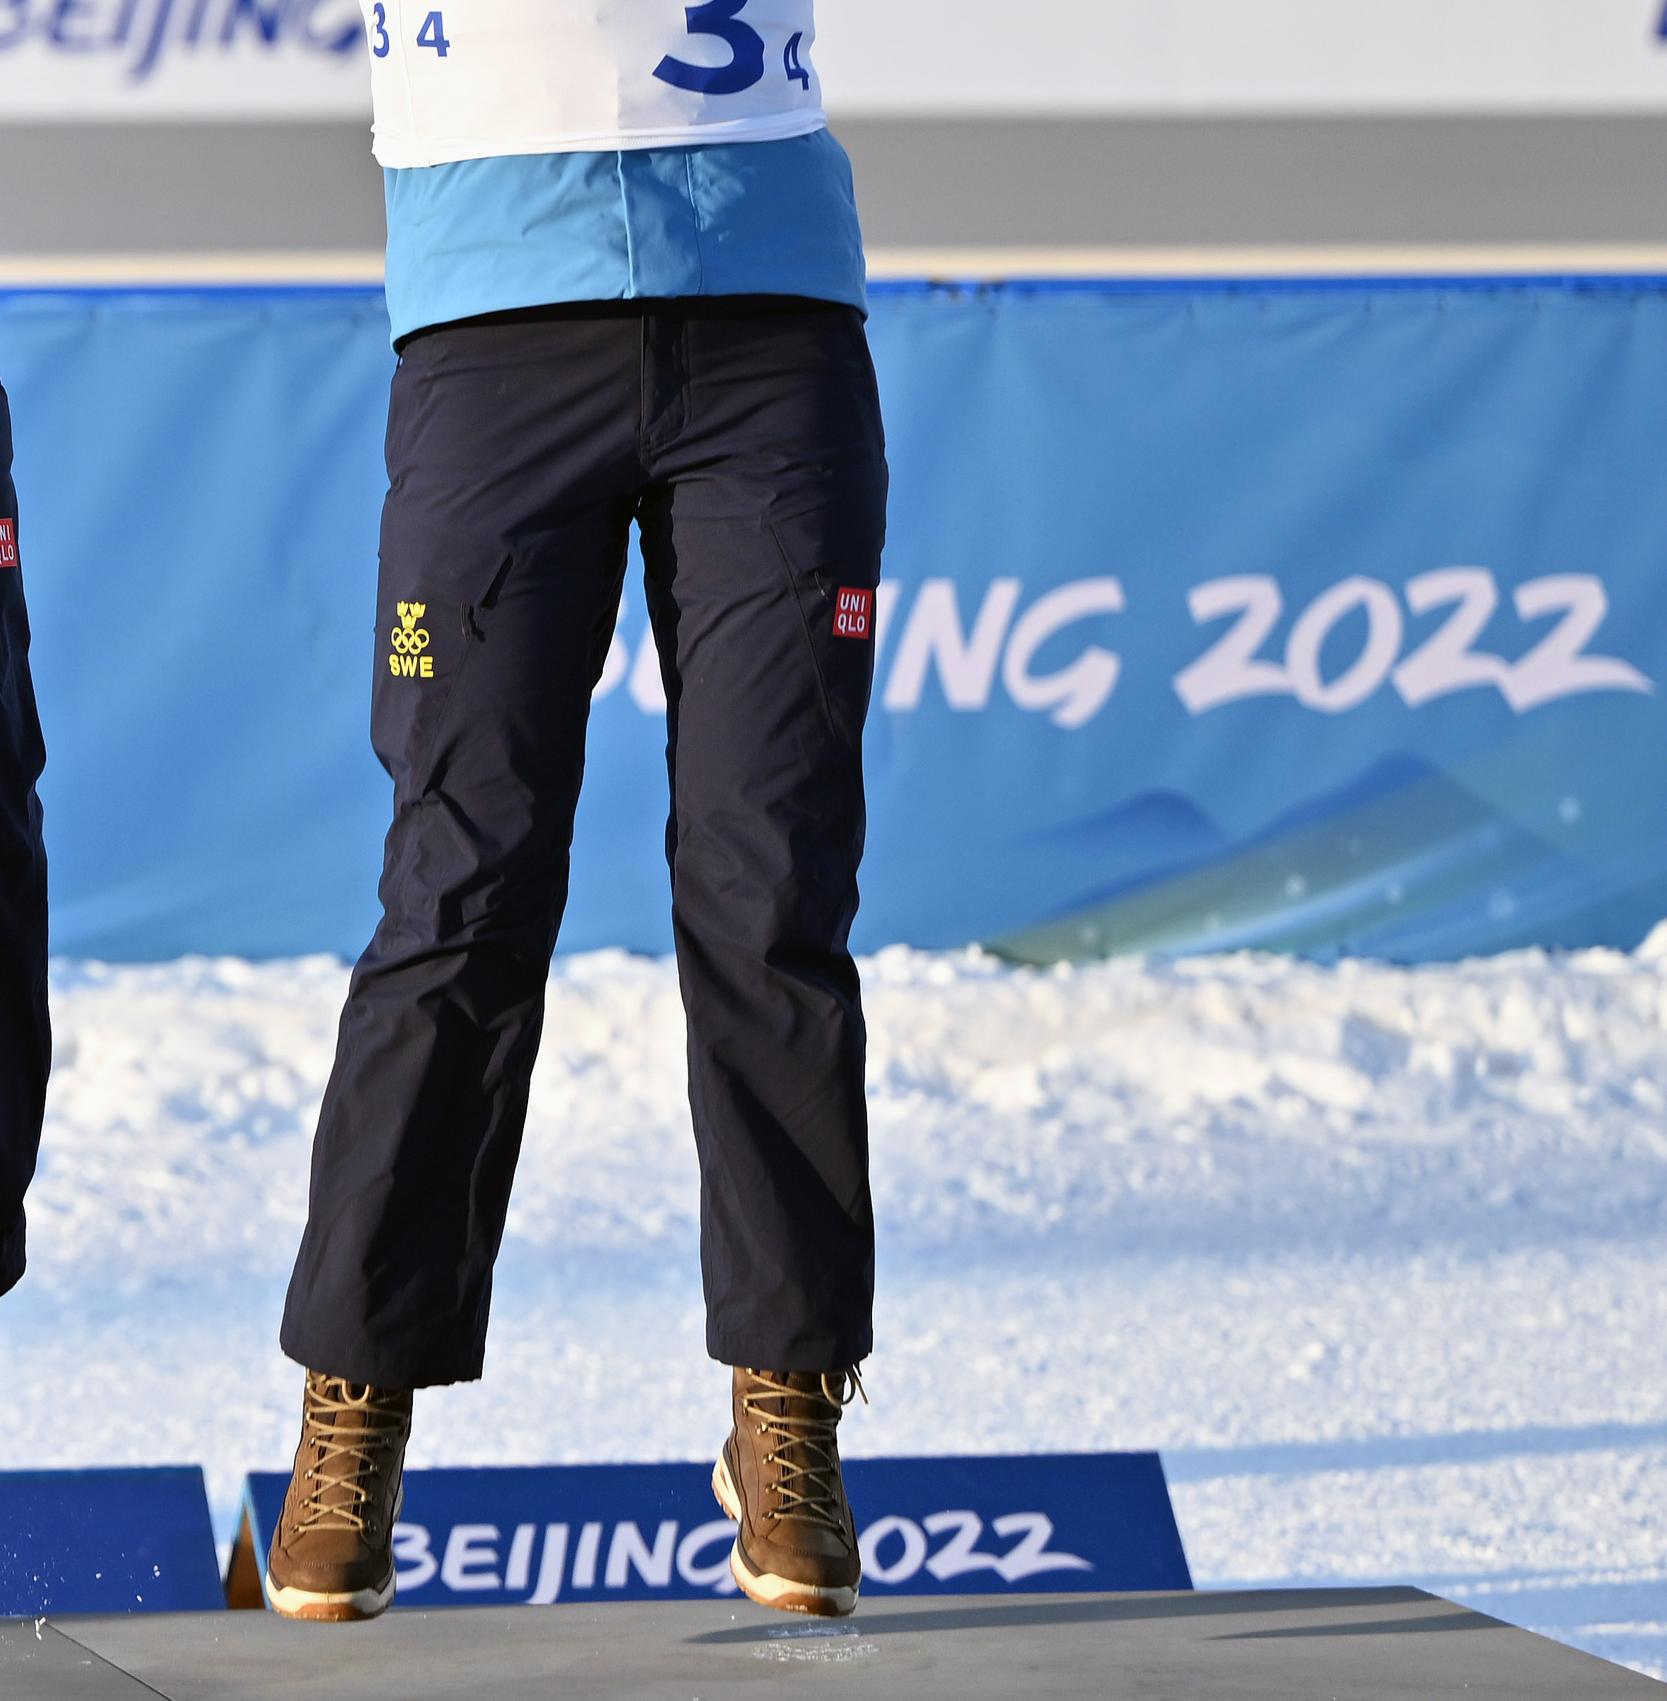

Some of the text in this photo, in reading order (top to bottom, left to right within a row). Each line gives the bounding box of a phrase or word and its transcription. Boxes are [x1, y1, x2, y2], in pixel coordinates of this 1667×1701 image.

[417, 11, 450, 57] 4
[783, 31, 810, 91] 4
[837, 613, 866, 634] QLO
[840, 592, 866, 613] UNI
[1172, 566, 1655, 716] 2022
[389, 654, 434, 678] SWE
[858, 1510, 1095, 1584] 022
